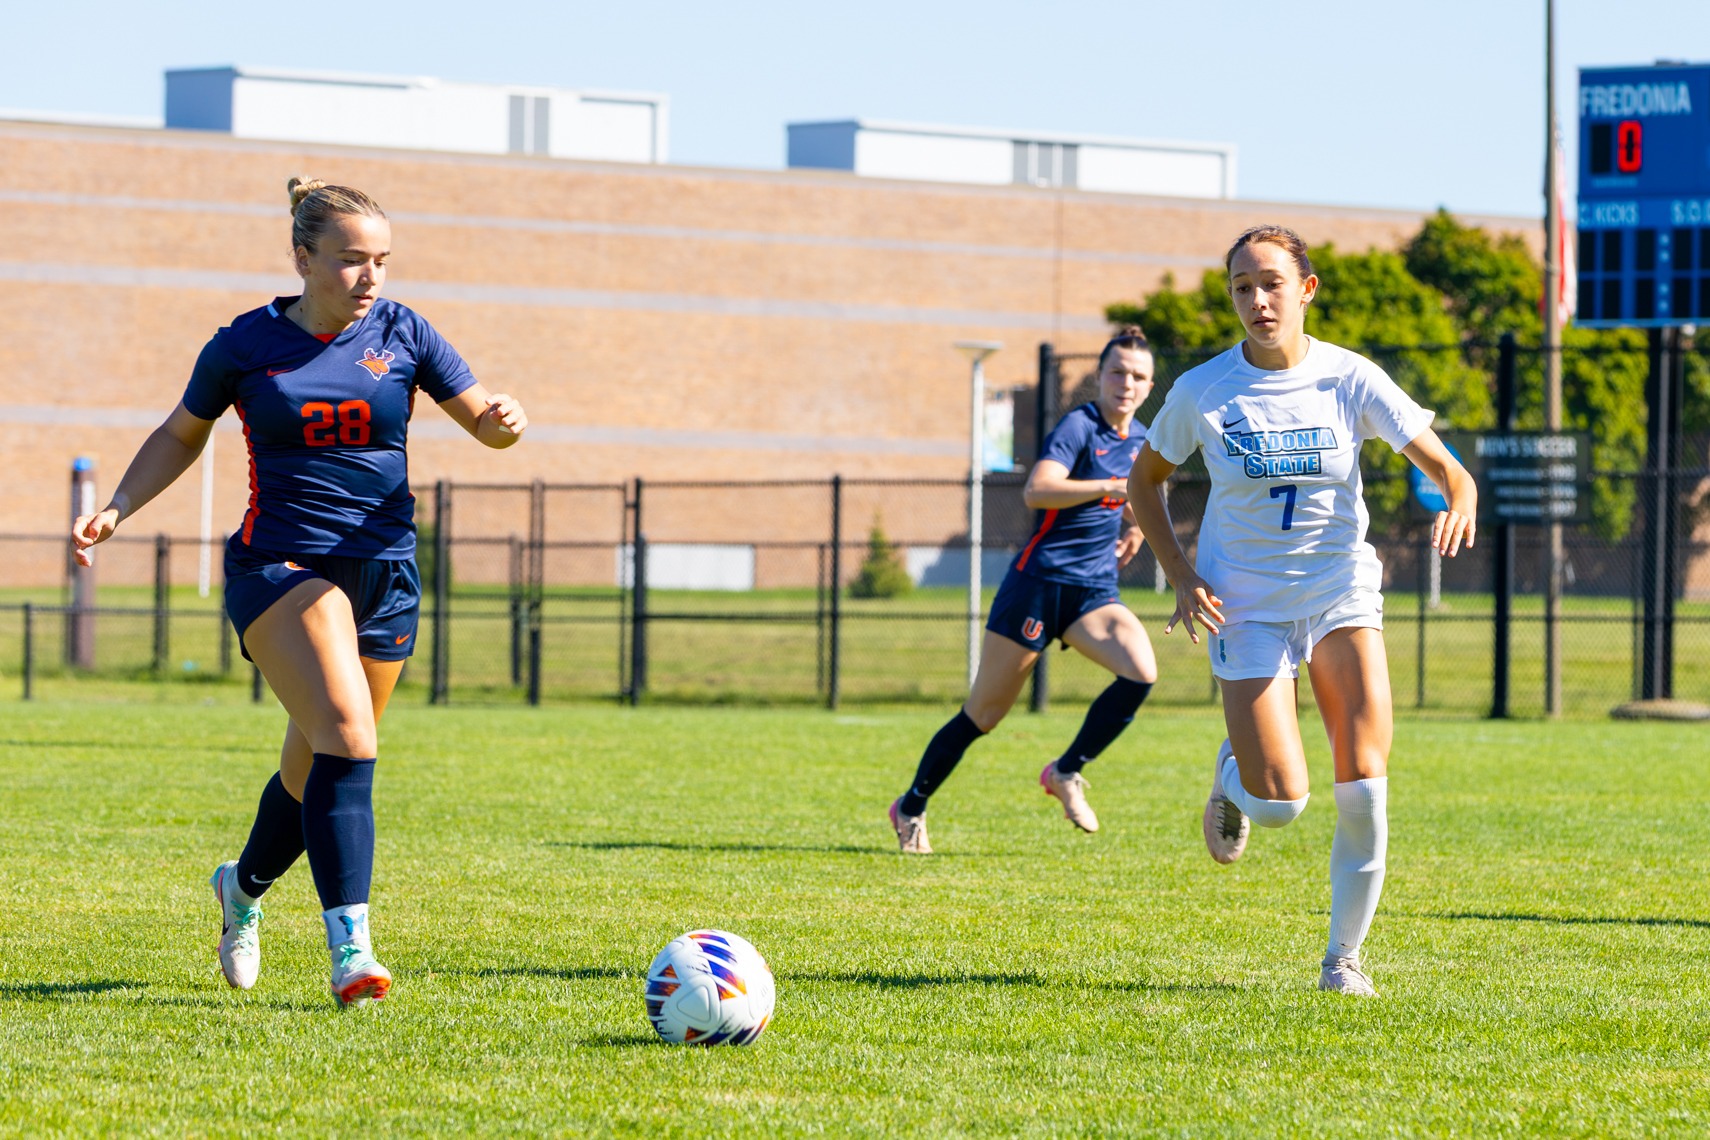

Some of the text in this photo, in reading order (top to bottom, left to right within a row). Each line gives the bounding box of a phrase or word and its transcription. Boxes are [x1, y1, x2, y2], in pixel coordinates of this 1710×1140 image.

[1579, 82, 1692, 117] FREDONIA
[1618, 121, 1642, 172] 0
[1595, 202, 1639, 226] KICKS
[301, 399, 372, 447] 28
[1222, 427, 1338, 456] FREDONIA
[1475, 436, 1577, 457] MEN'S SOCCER
[1244, 451, 1321, 478] STATE
[1270, 484, 1297, 530] 7
[1021, 617, 1044, 641] U
